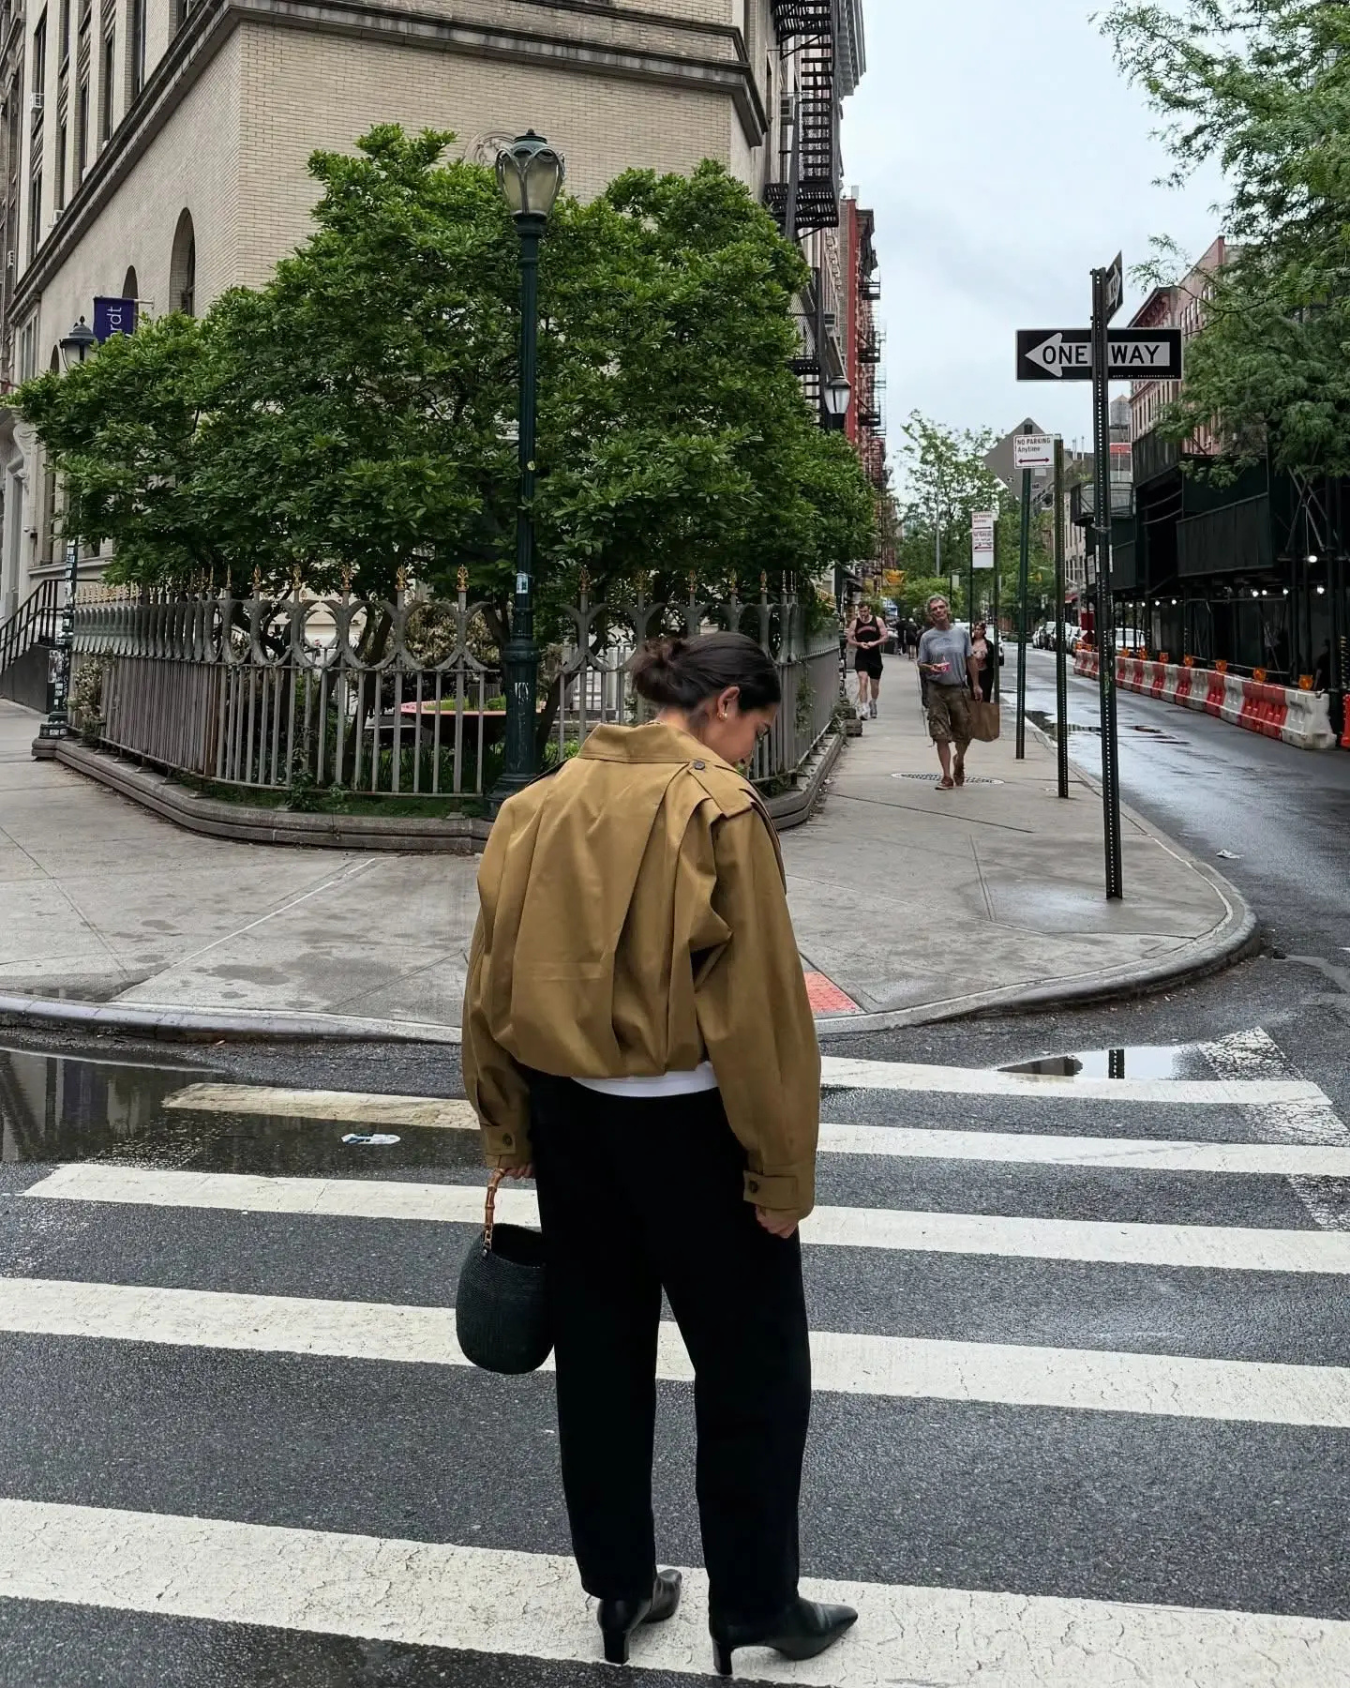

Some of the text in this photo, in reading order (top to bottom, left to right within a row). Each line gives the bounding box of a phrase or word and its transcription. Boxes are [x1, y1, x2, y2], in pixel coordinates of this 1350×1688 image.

[106, 306, 122, 336] rdt
[1042, 344, 1160, 365] ONE WAY
